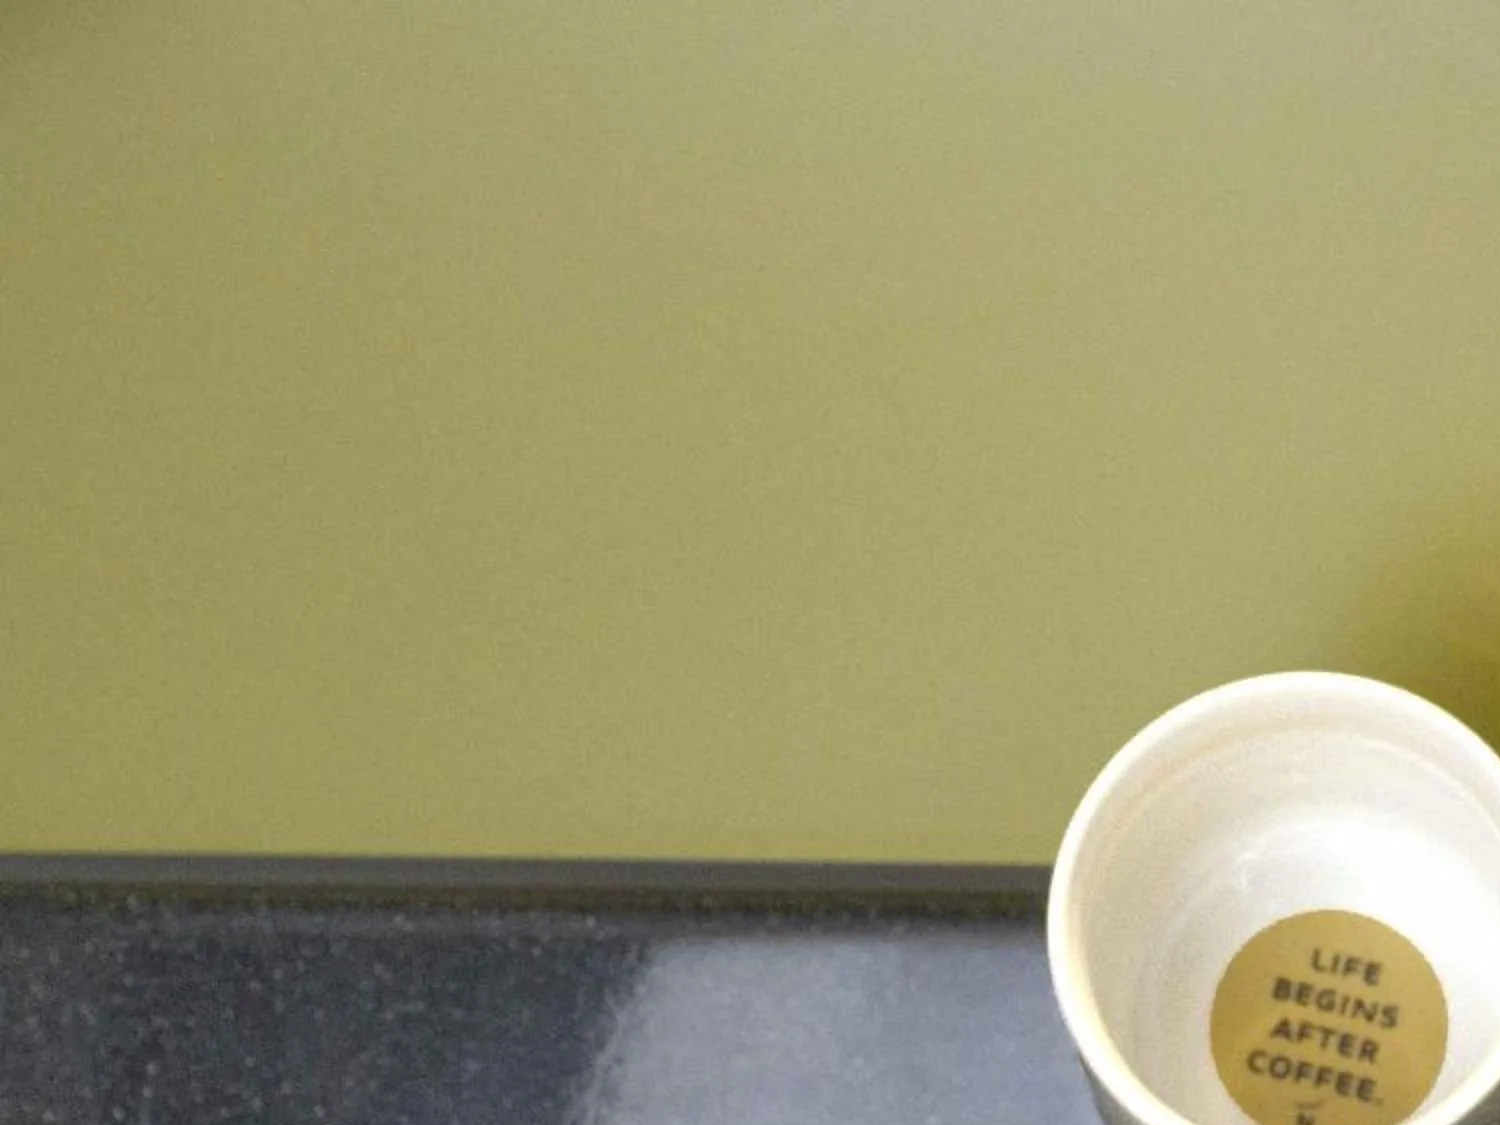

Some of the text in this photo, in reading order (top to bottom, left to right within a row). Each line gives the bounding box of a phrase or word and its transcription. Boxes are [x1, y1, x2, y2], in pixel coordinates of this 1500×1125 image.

[1311, 948, 1383, 987] LIFE
[1271, 976, 1400, 1029] BEGINS
[1270, 1017, 1380, 1064] AFTER
